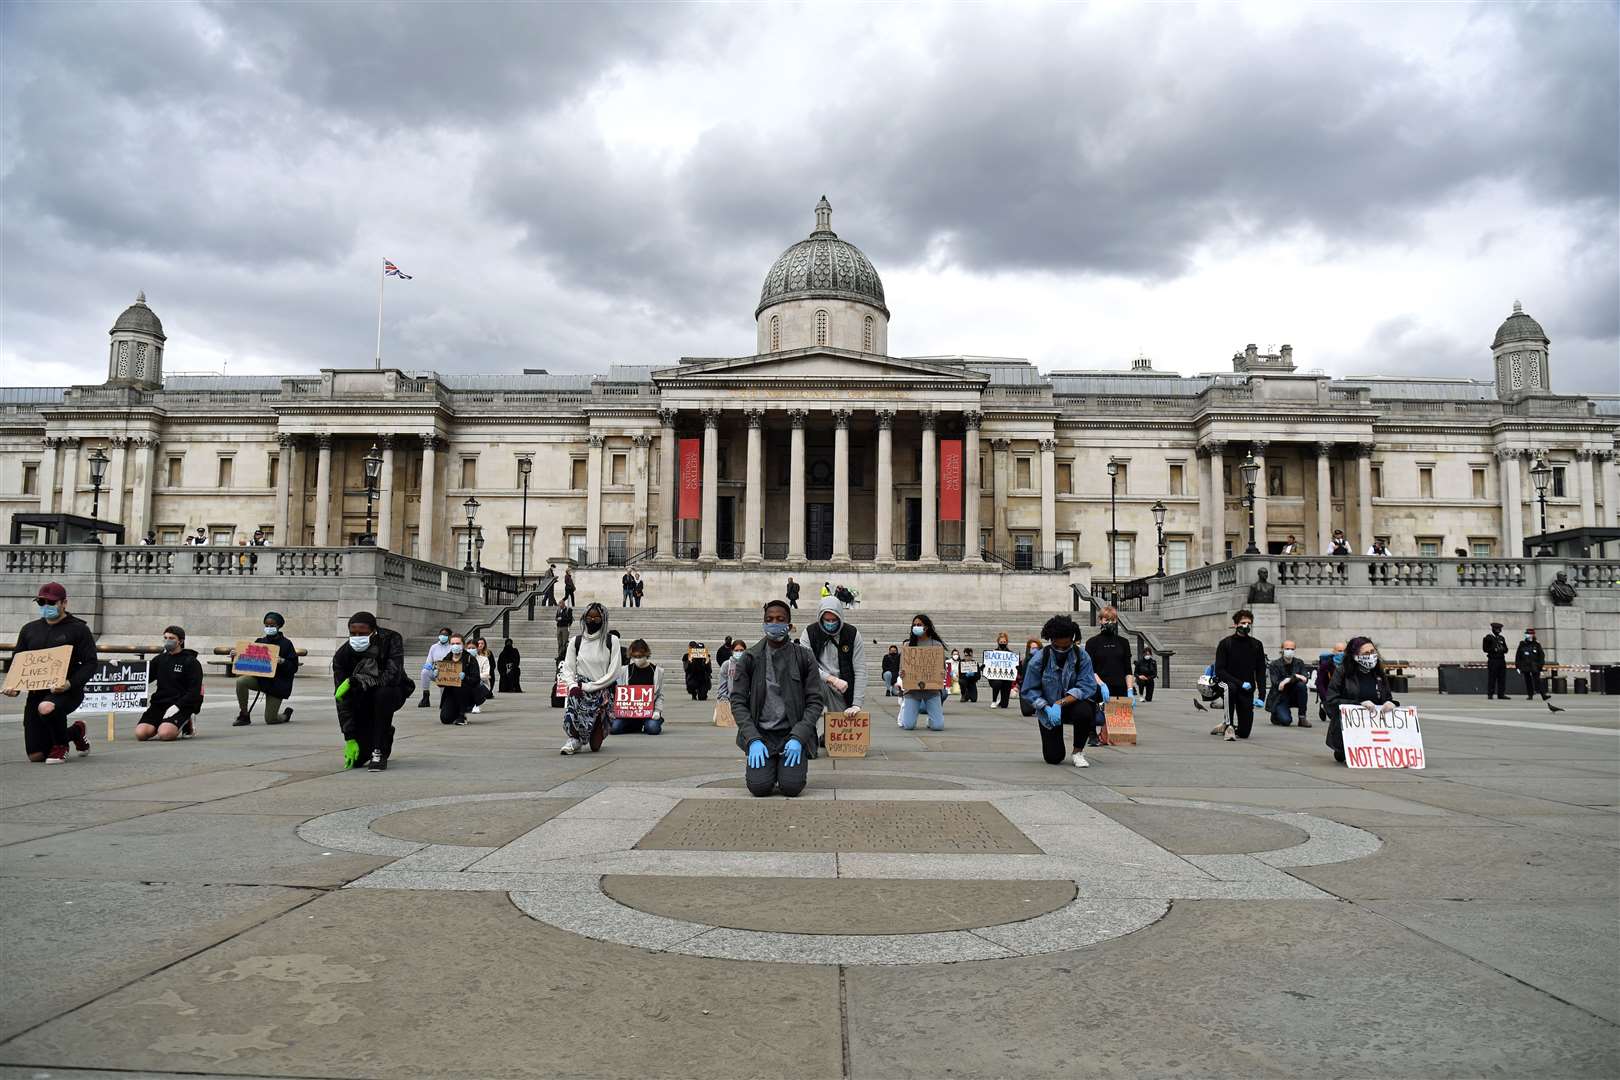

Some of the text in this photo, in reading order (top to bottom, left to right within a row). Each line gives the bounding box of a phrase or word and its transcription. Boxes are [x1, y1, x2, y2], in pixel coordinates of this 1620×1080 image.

[985, 652, 1018, 662] BLACK LIVES
[991, 660, 1012, 668] MATTER
[21, 667, 48, 677] LIVES
[16, 677, 58, 689] MATTER
[114, 692, 137, 701] BELLY
[616, 687, 653, 702] BLM
[830, 718, 869, 728] JUSTICE
[830, 732, 863, 741] BELLY
[1348, 746, 1423, 768] NOT ENOUGH
